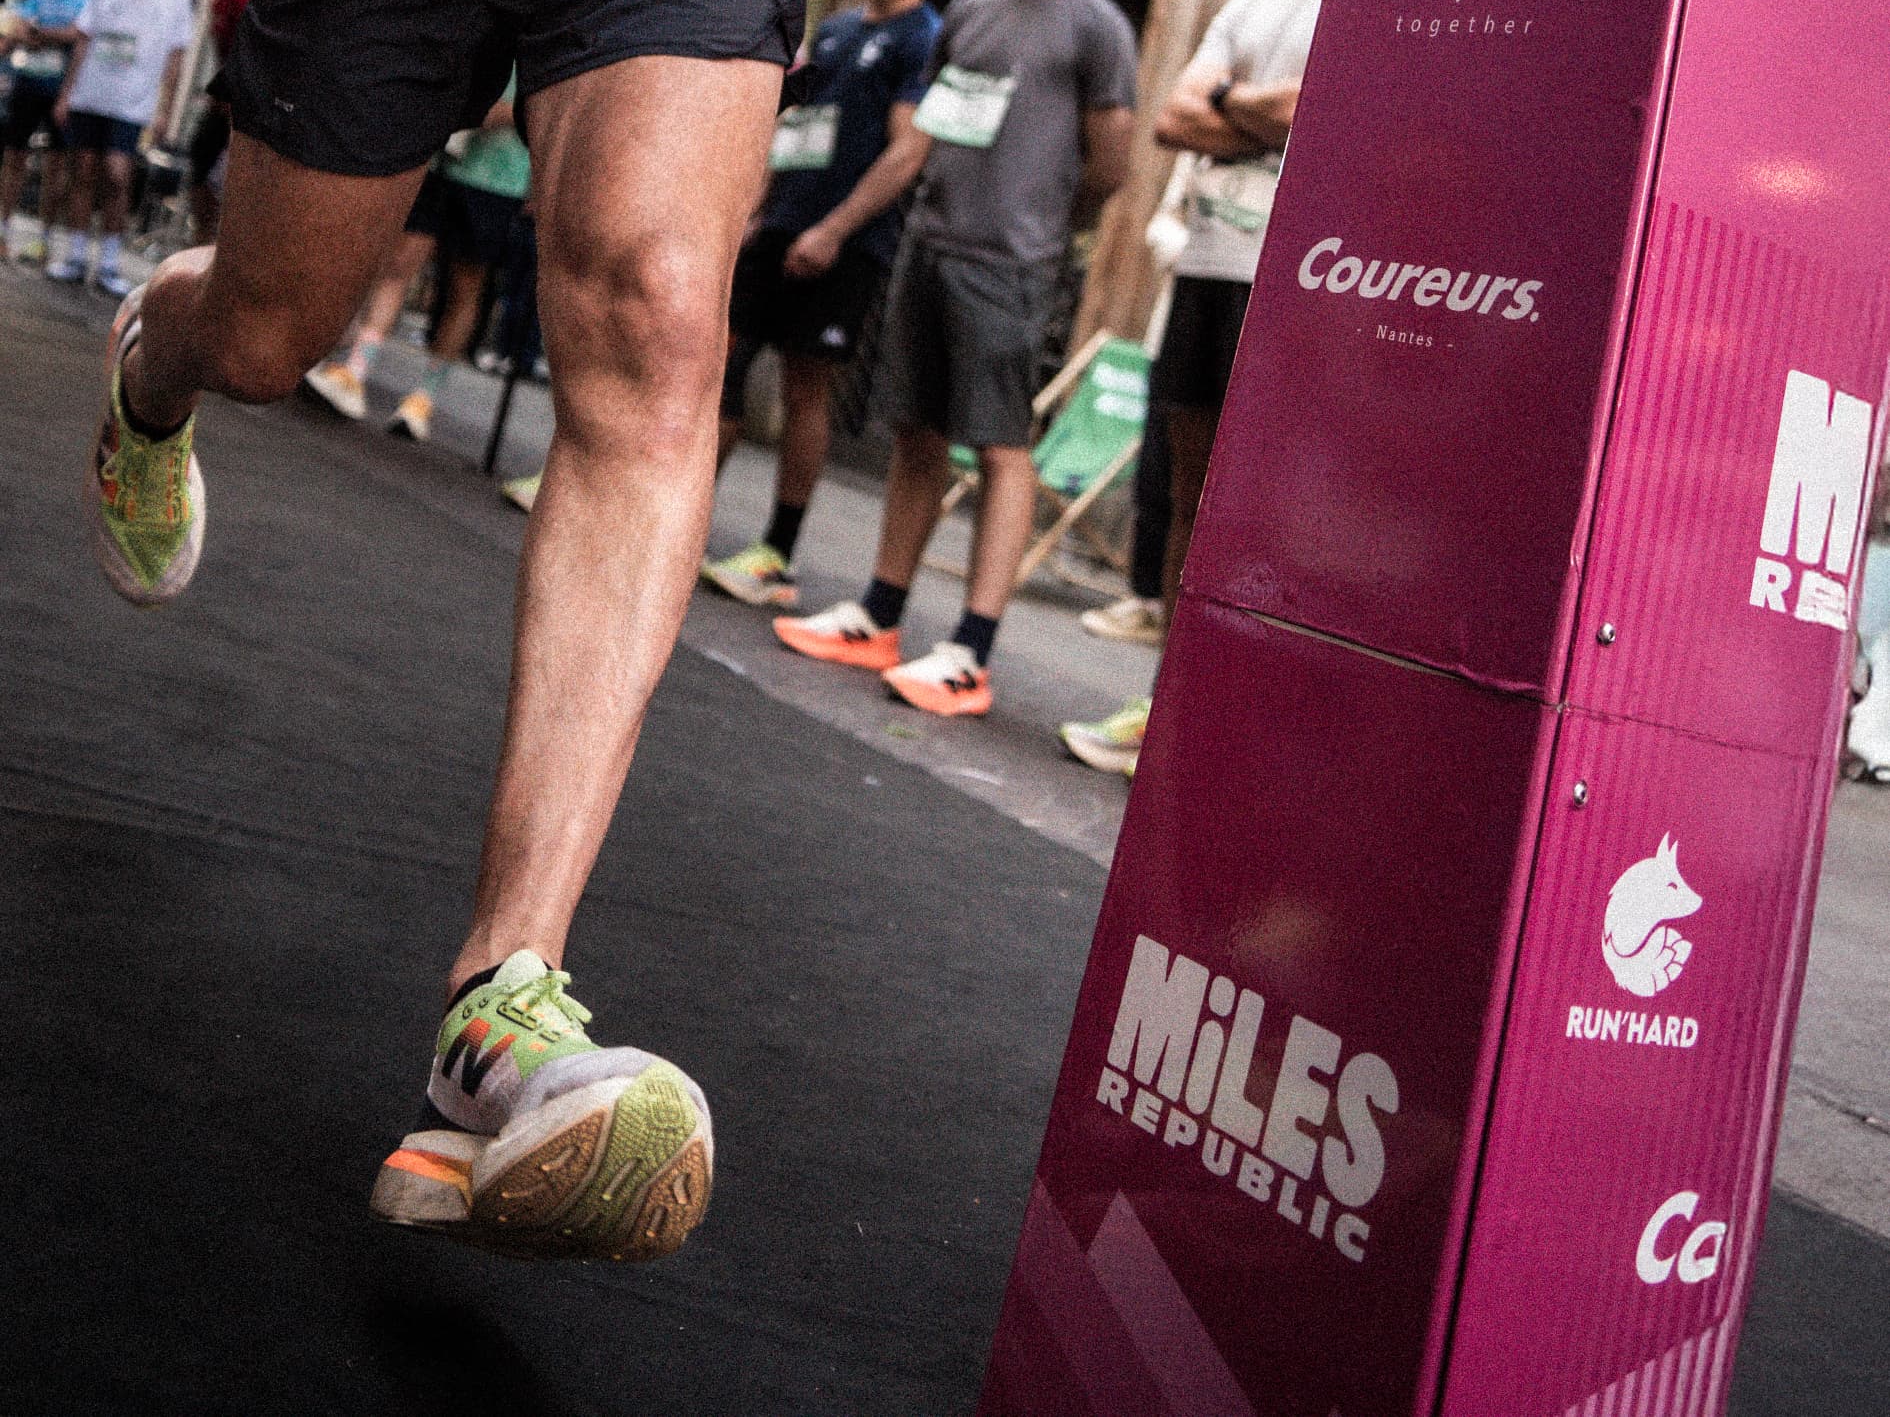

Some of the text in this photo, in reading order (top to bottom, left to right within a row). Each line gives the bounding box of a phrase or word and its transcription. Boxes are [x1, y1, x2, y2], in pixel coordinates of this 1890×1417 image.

[1396, 14, 1535, 38] together
[1297, 236, 1545, 323] Coureurs.
[1376, 324, 1434, 348] Nantes
[1565, 1005, 1699, 1049] RUN'HARD
[1095, 1066, 1371, 1264] REPUBLIC
